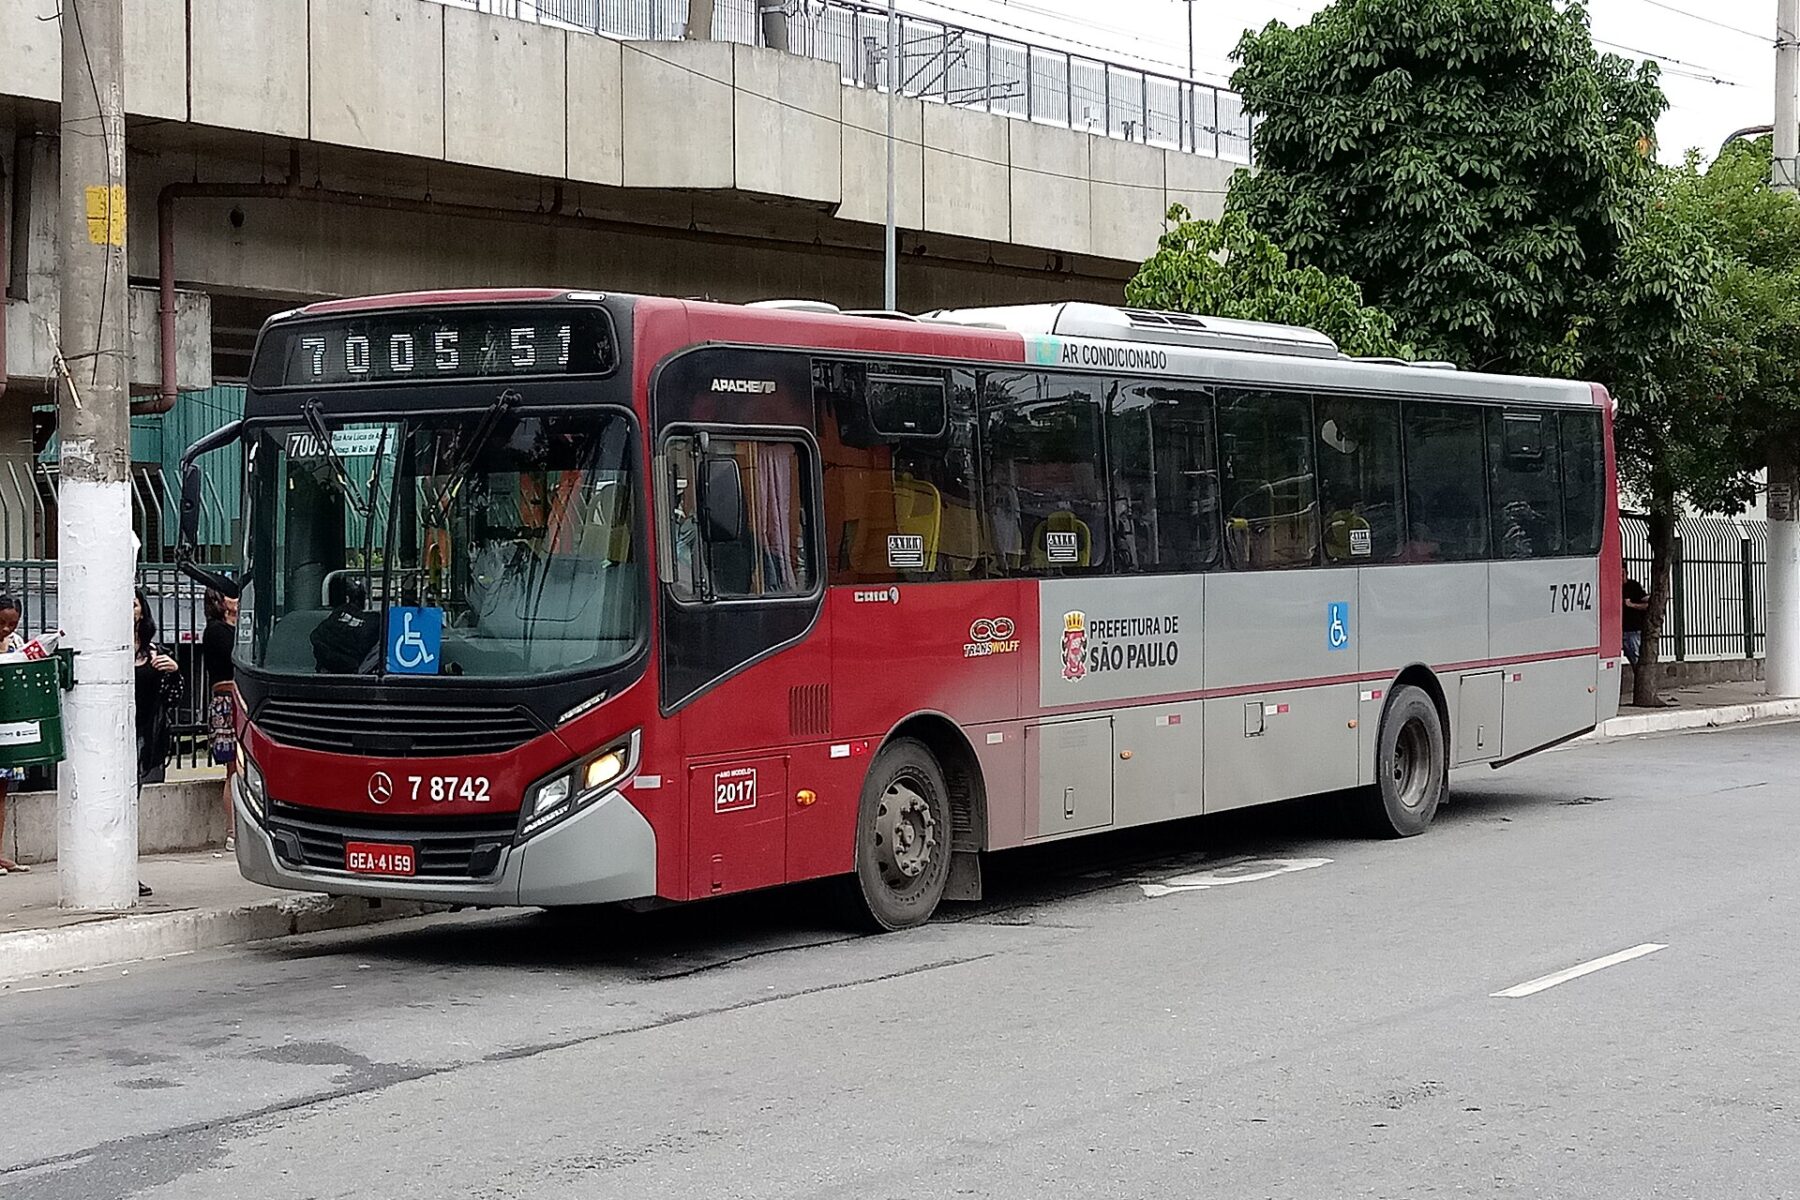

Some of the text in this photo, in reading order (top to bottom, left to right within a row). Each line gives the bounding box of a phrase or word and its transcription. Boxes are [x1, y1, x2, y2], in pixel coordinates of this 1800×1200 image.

[1062, 343, 1167, 370] AR CONDICIONADO
[1550, 582, 1592, 613] 7 8742
[1090, 615, 1179, 640] PREFEITURA DE
[963, 640, 1021, 658] TRANSWOLFF
[1090, 640, 1179, 673] SÃO PAULO
[408, 776, 490, 802] 7 8742
[717, 780, 754, 804] 2017
